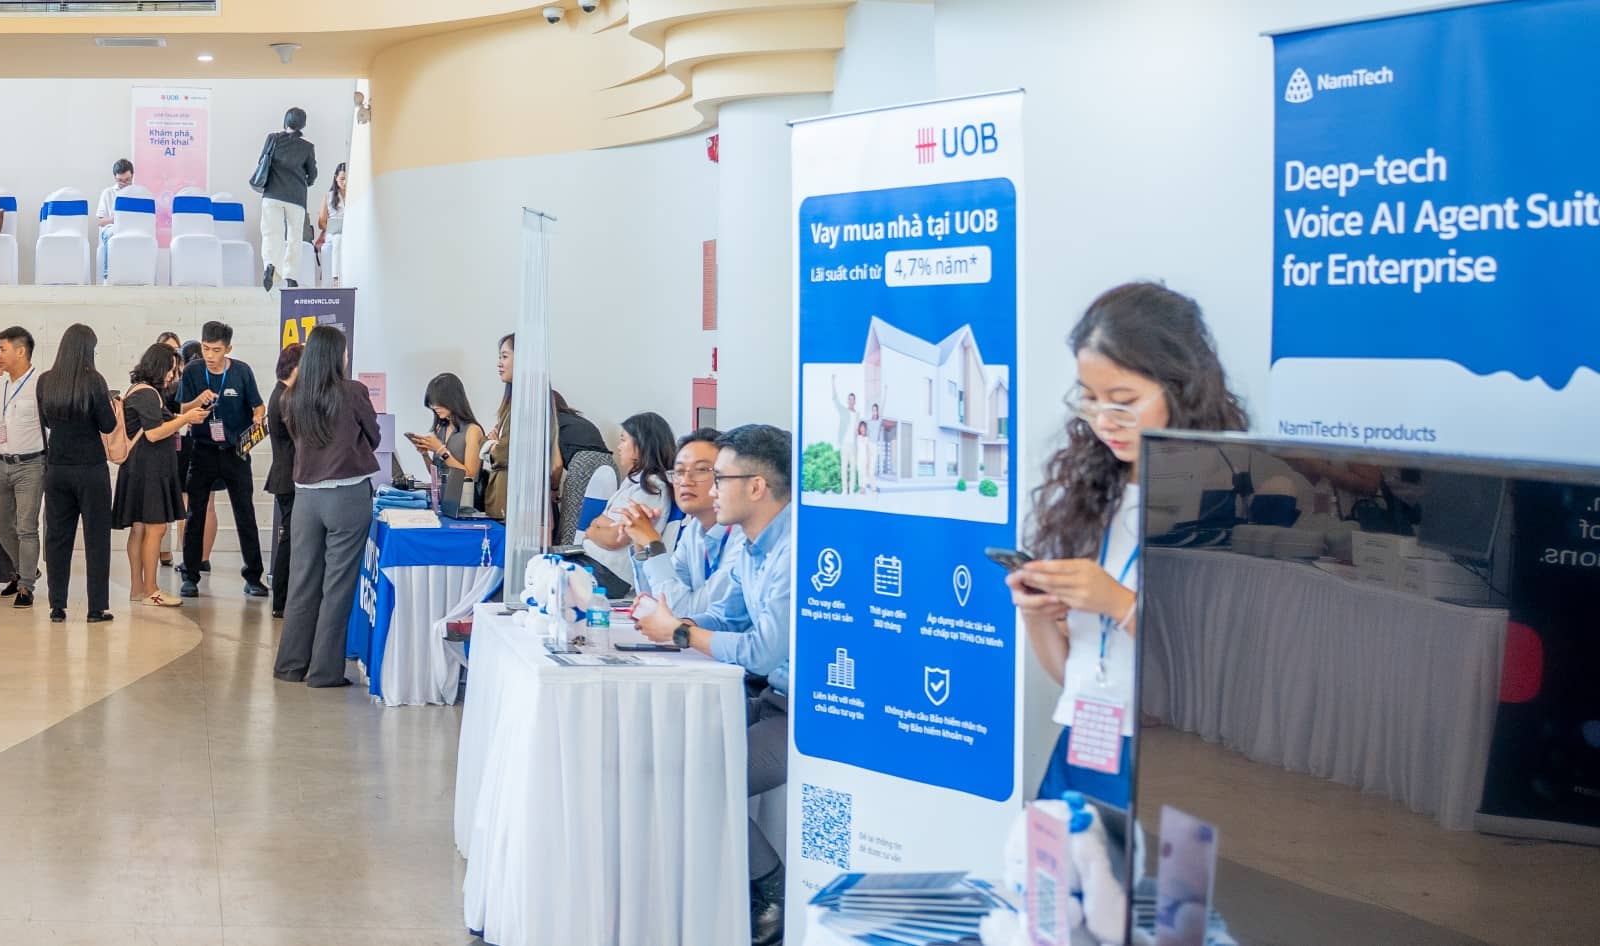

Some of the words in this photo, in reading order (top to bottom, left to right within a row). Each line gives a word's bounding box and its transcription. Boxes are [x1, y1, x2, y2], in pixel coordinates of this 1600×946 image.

[1317, 66, 1393, 91] NamiTech
[164, 147, 176, 156] AI
[942, 122, 998, 158] UOB
[1285, 147, 1447, 197] Deep-tech
[810, 222, 840, 249] Vay
[843, 222, 884, 241] mua
[888, 212, 922, 239] nhà
[926, 212, 949, 241] tại
[954, 208, 998, 234] UOB
[1284, 205, 1363, 239] Voice
[1370, 201, 1405, 235] AI
[1413, 197, 1520, 240] Agent
[849, 263, 868, 281] chỉ
[894, 257, 931, 280] 4,7%
[1283, 254, 1322, 286] for
[1328, 248, 1497, 294] Enterprise
[1278, 420, 1360, 439] NamiTech's
[1364, 424, 1437, 444] products
